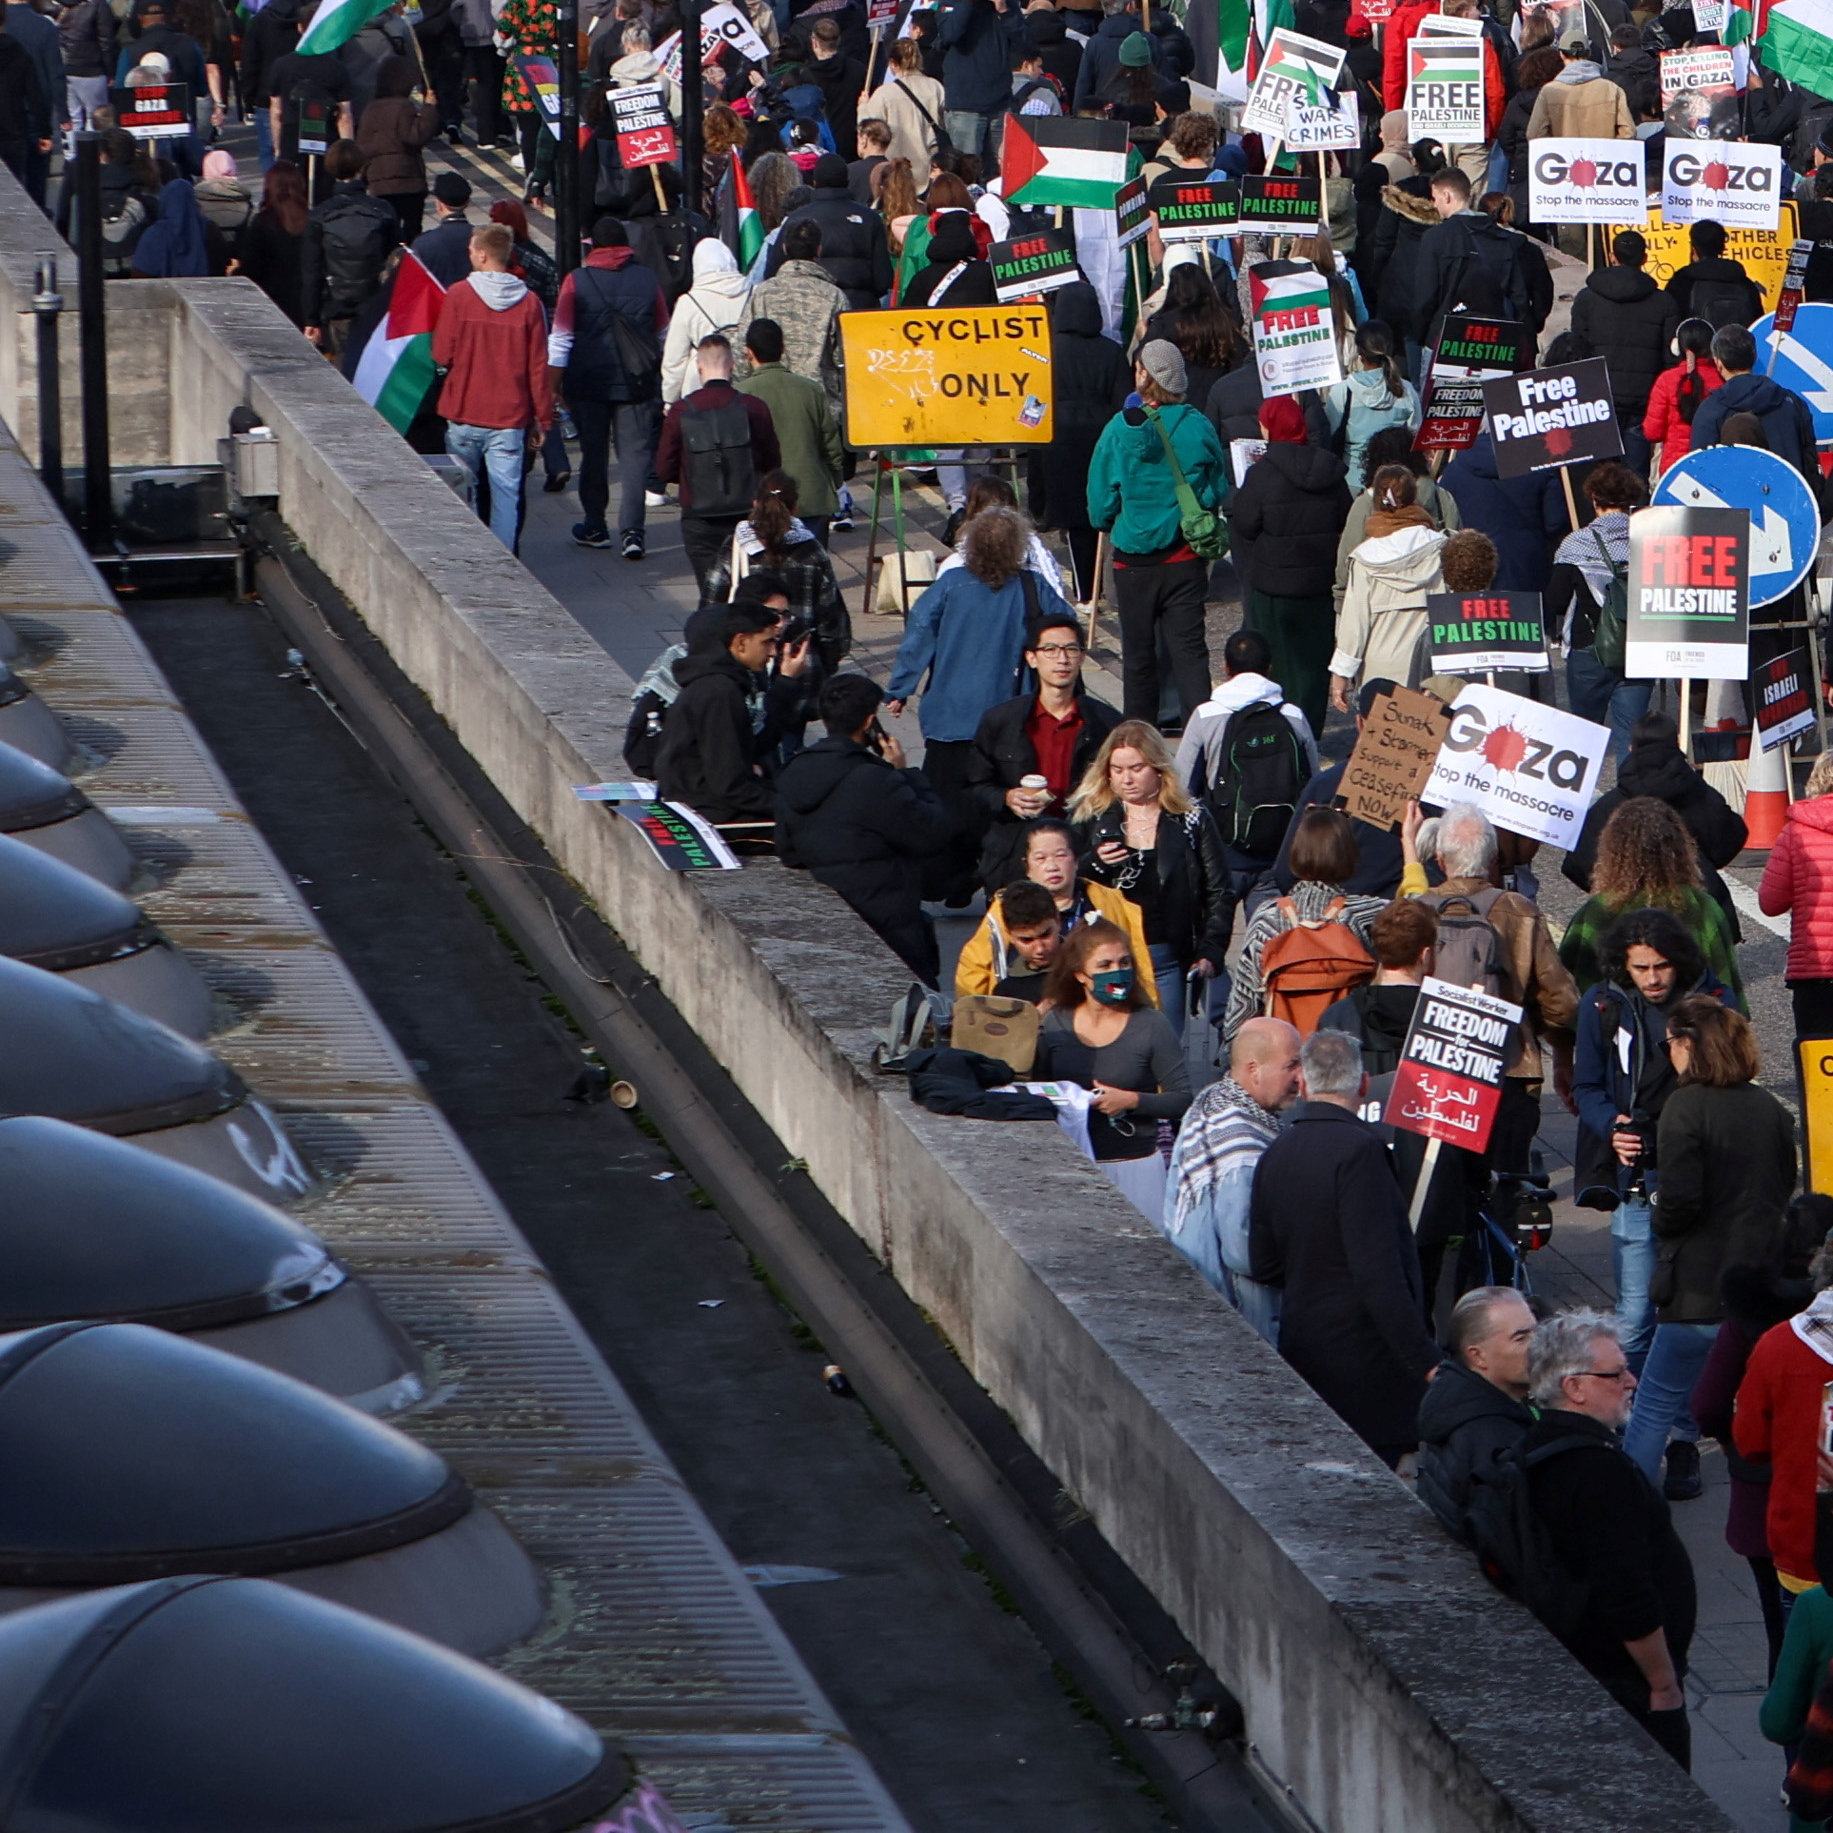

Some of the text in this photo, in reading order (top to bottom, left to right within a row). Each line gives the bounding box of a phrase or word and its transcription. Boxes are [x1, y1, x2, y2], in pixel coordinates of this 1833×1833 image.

[1411, 83, 1481, 107] FREE
[1300, 110, 1341, 123] WAR
[1411, 109, 1481, 121] PALESTINE
[1288, 124, 1355, 143] CRIMES
[902, 317, 1043, 342] CYCLIST
[1263, 304, 1319, 336] FREE
[1257, 328, 1331, 353] PALESTINE
[940, 372, 1030, 397] ONLY
[1517, 375, 1577, 406] Free
[1493, 399, 1611, 443] Palestine
[1382, 701, 1434, 736] Sunak
[1358, 795, 1399, 820] NOW
